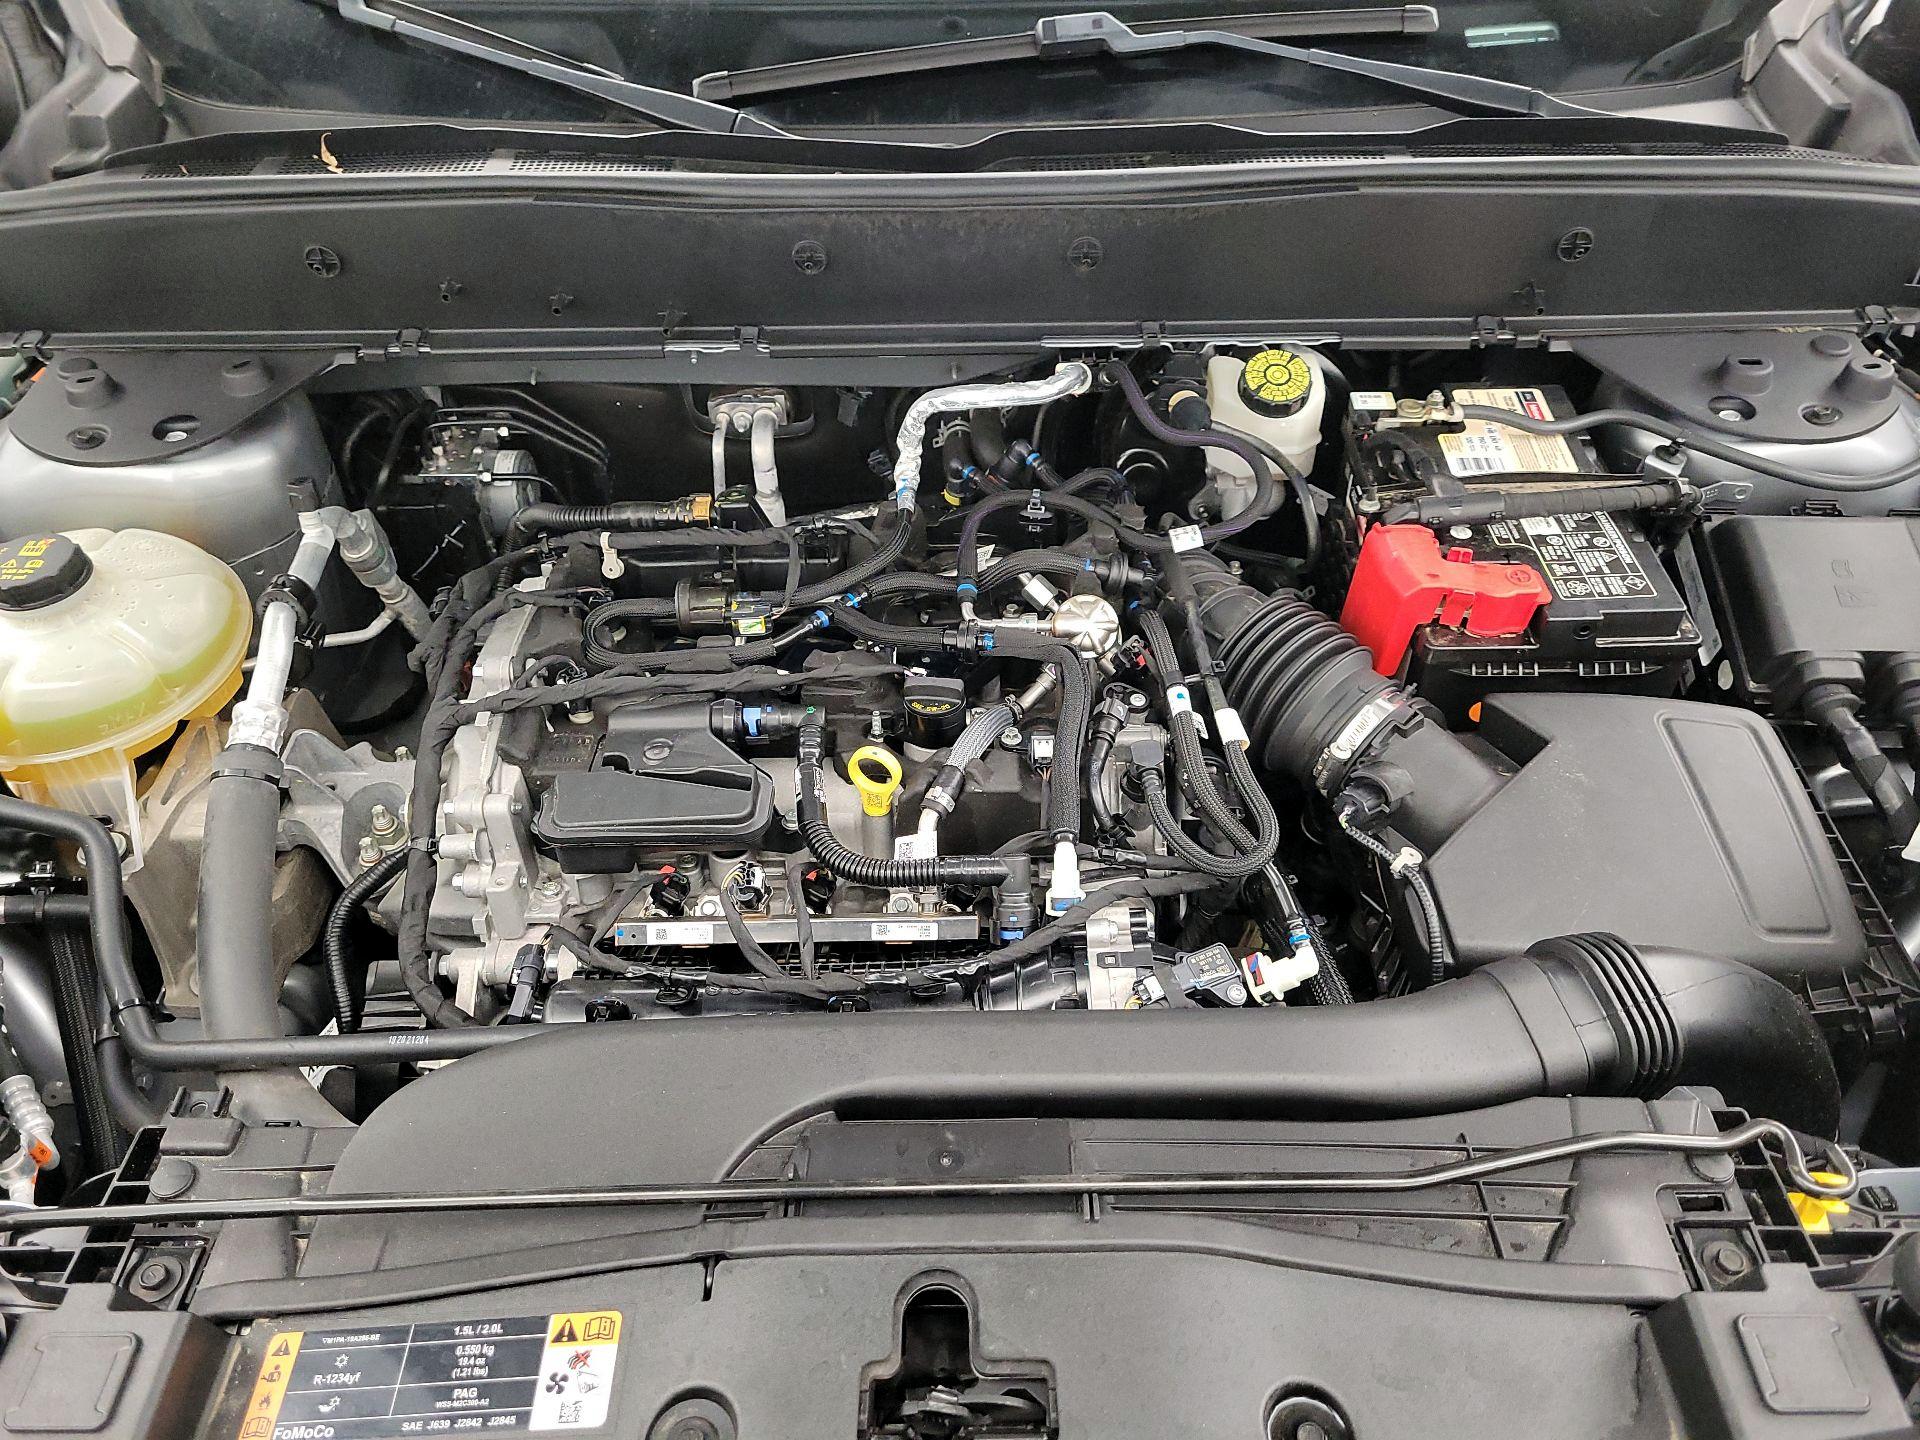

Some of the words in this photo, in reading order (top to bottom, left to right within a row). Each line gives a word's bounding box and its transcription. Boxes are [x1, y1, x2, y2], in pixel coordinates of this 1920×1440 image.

[453, 1325, 475, 1336] 1.5L
[481, 1323, 503, 1334] 2.0L
[455, 1344, 482, 1357] 0.550
[482, 1343, 495, 1357] kg
[458, 1356, 475, 1366] 19.4
[475, 1357, 487, 1366] oz
[313, 1371, 362, 1385] R-1234yf
[451, 1367, 472, 1379] (1.21
[453, 1387, 478, 1399] PAG
[401, 1420, 423, 1431] SAE
[426, 1419, 451, 1430] J639
[453, 1417, 483, 1428] J2842
[487, 1415, 517, 1426] J2845
[272, 1424, 335, 1440] FoMoCo
